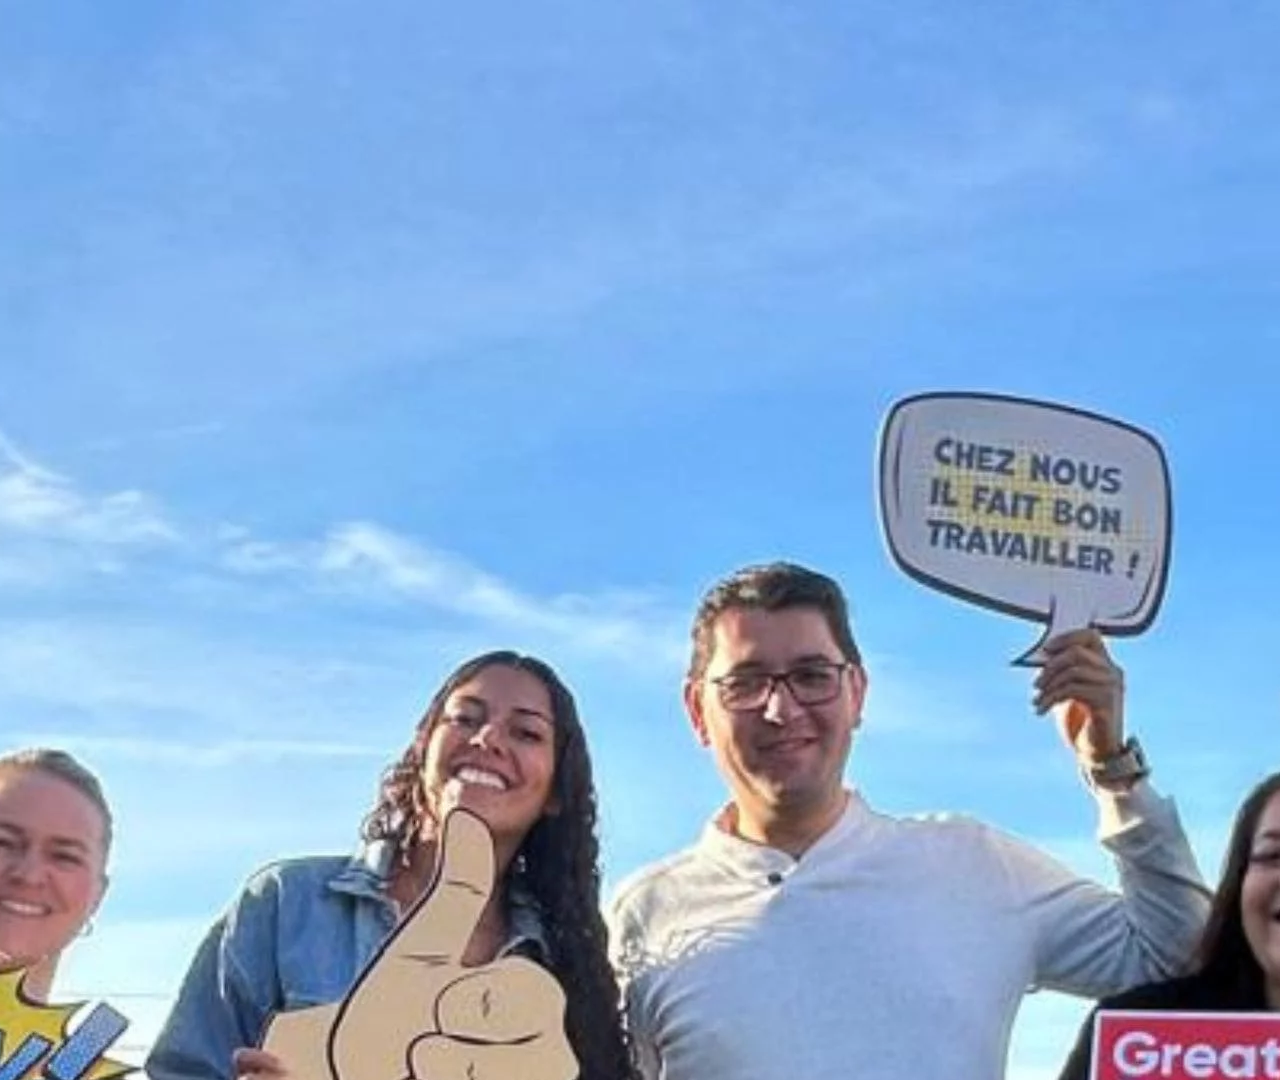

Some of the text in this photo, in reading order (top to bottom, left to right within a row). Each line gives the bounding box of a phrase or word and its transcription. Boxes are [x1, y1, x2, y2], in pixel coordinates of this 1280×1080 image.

[934, 437, 1121, 495] CHEZ NOUS
[930, 477, 1121, 534] IL FAIT BON
[927, 520, 1114, 576] TRAVAILLER
